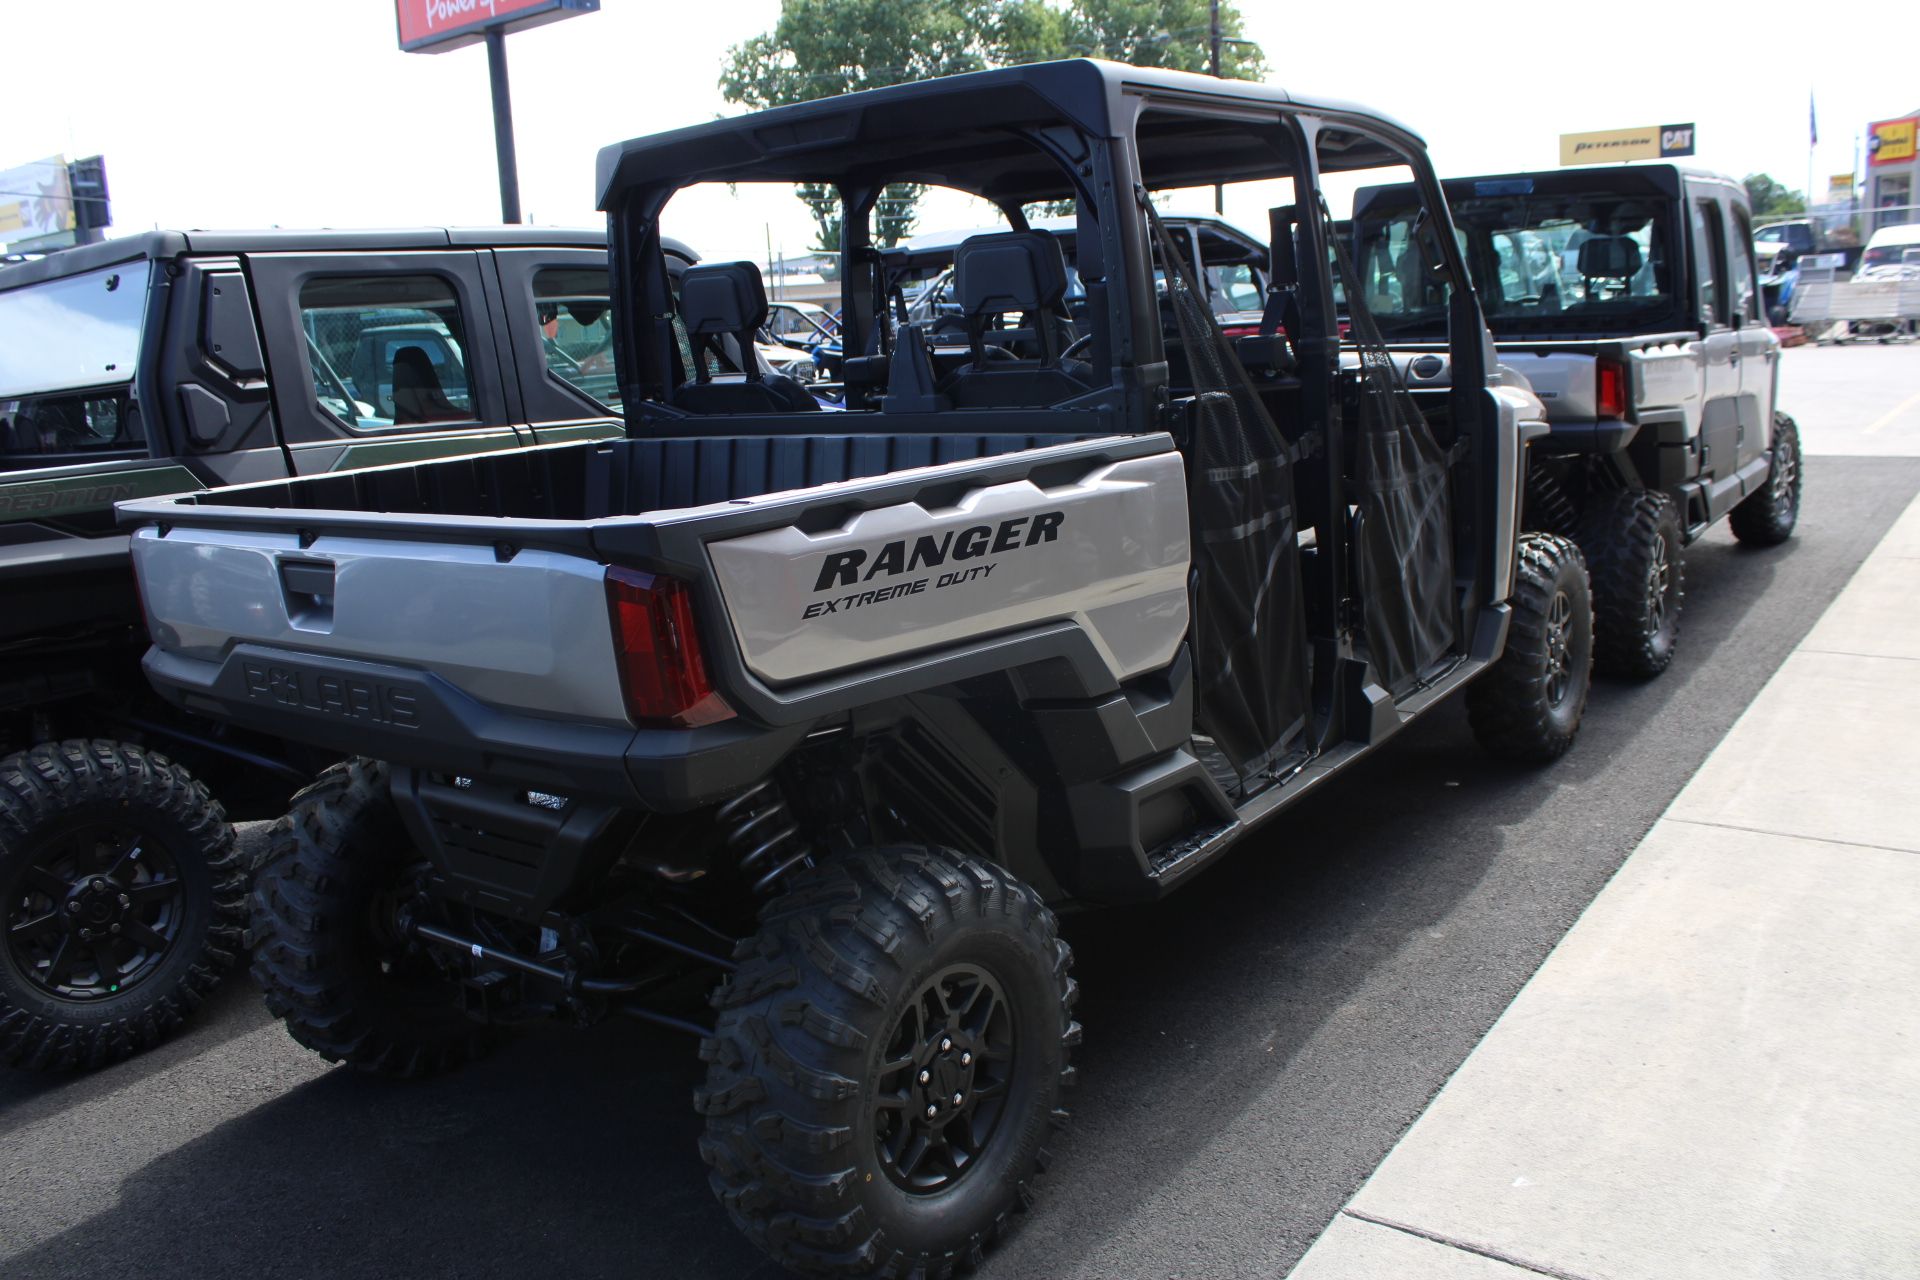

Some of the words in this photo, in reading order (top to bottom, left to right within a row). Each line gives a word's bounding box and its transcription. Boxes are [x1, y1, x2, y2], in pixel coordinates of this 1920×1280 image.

[1662, 129, 1693, 150] CAT
[813, 511, 1065, 592] RANGER
[801, 578, 930, 620] EXTREME
[935, 563, 998, 589] DUTY
[243, 662, 422, 729] POLARIS
